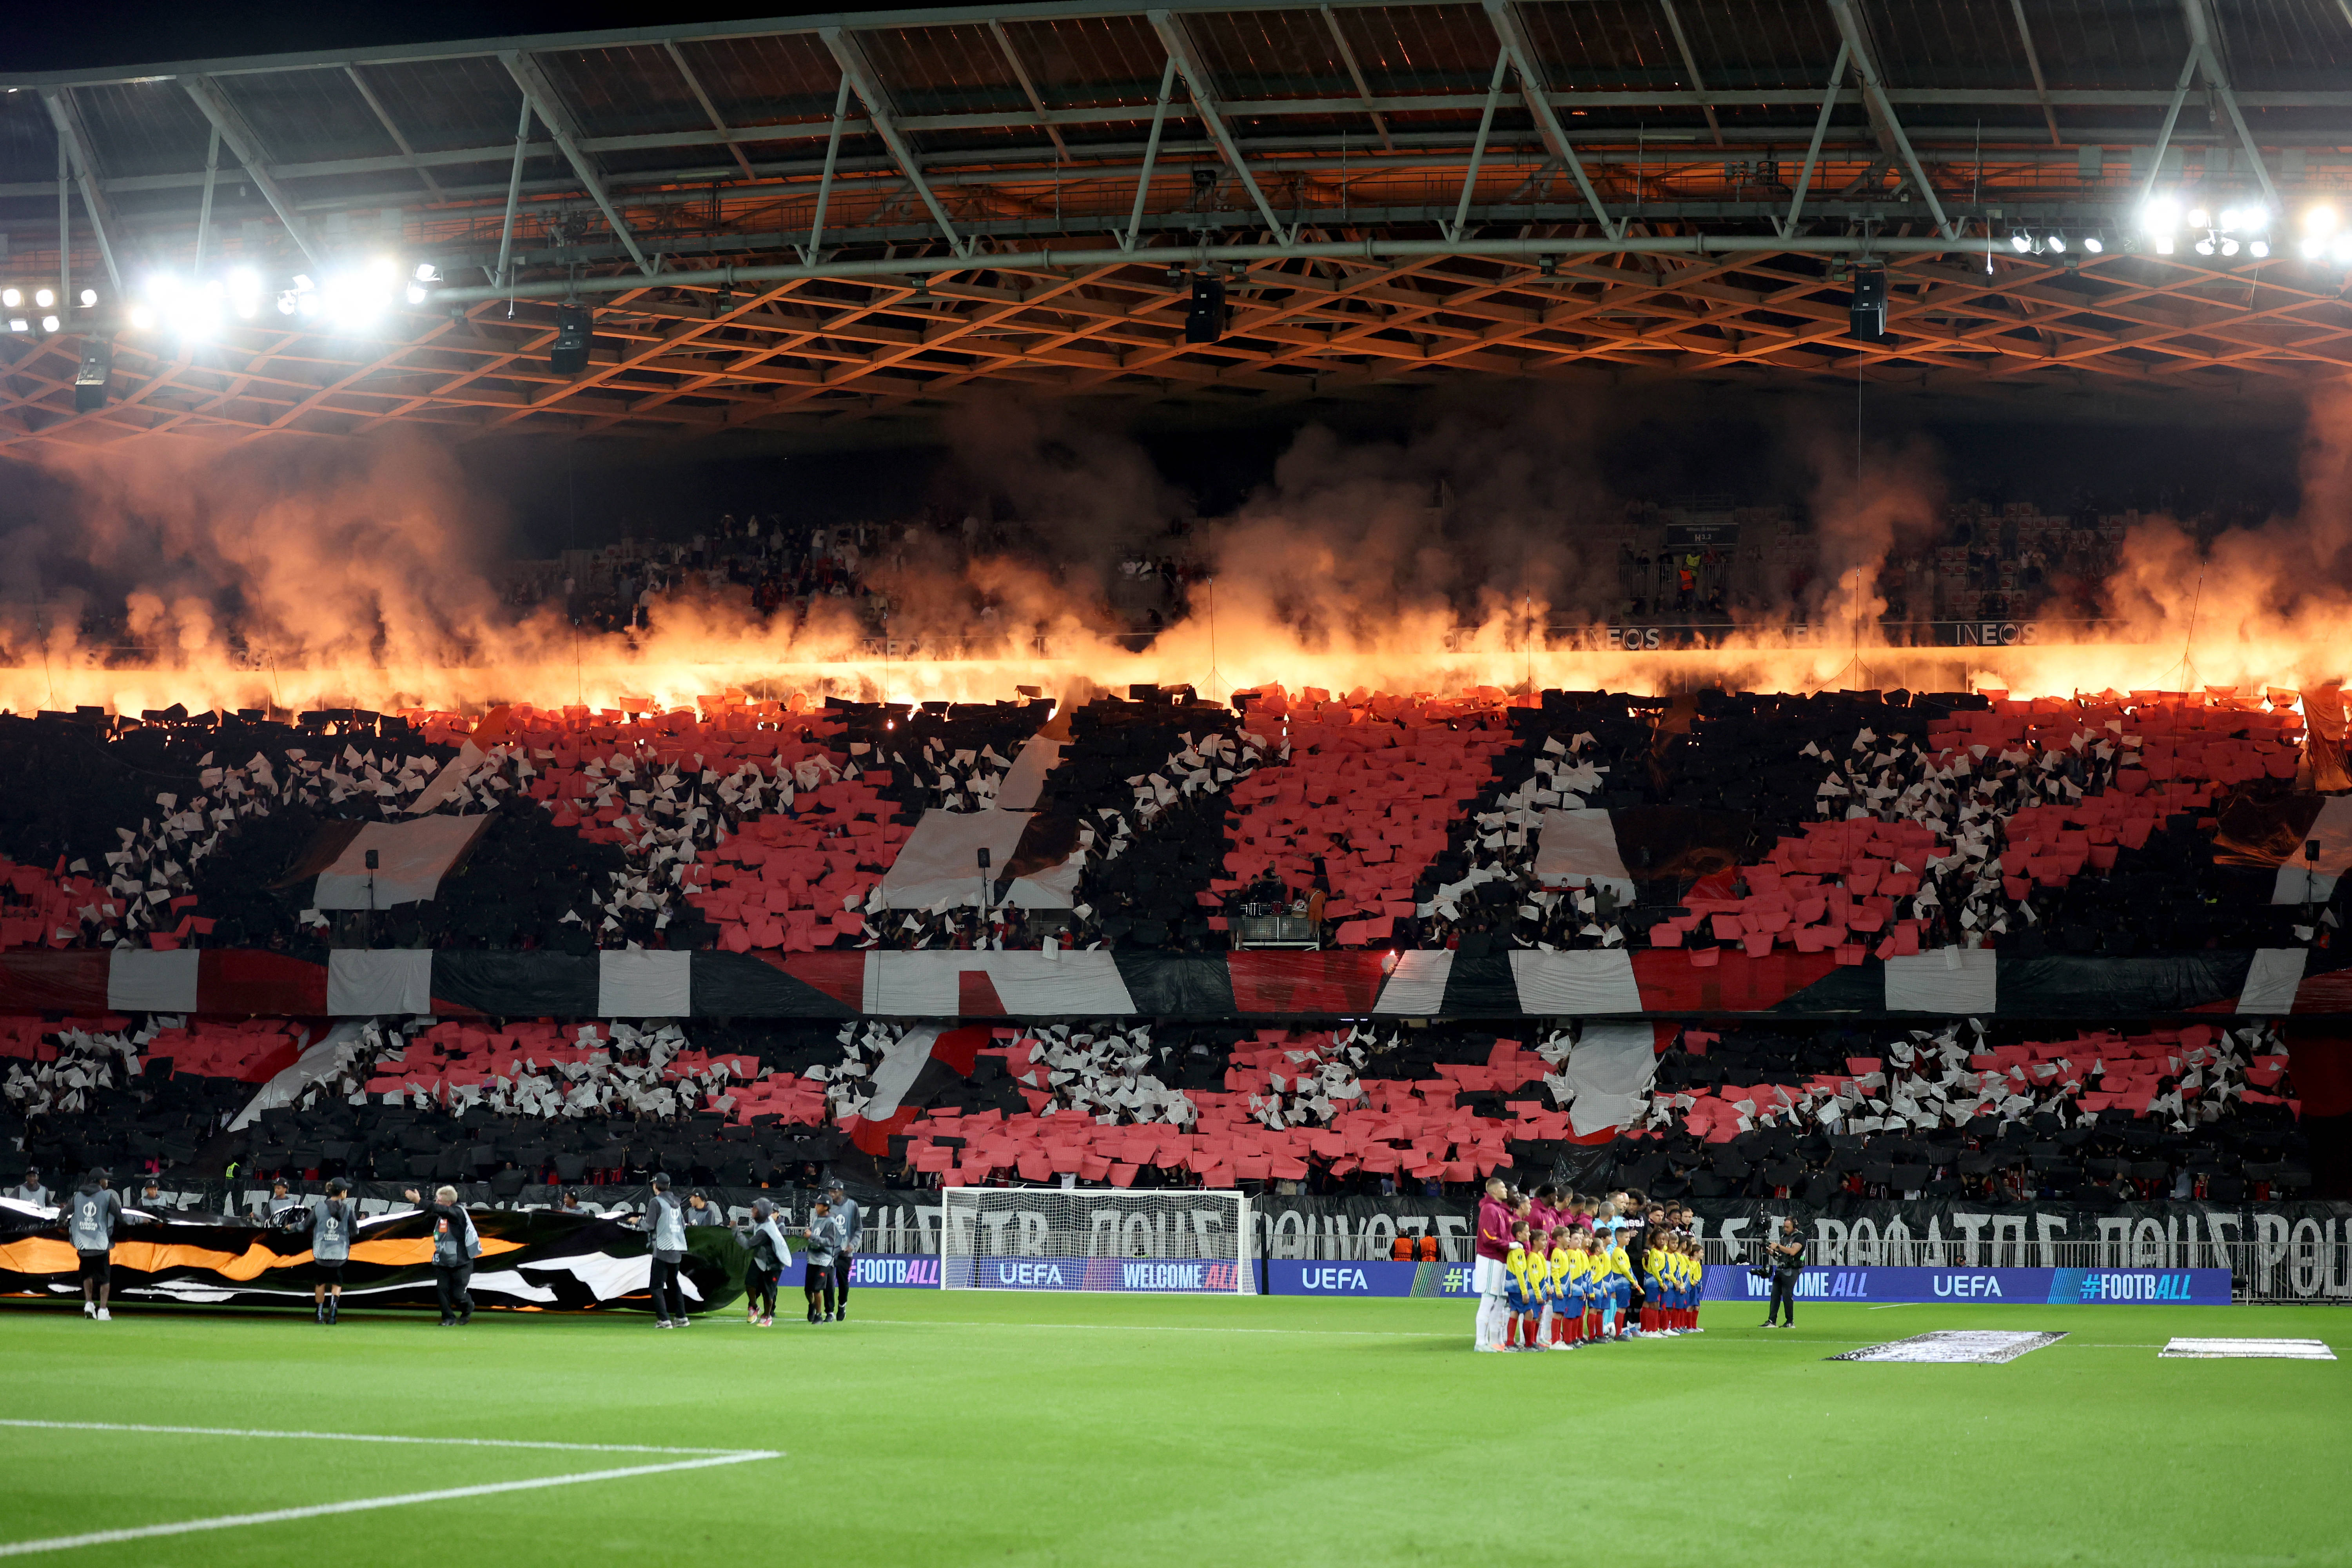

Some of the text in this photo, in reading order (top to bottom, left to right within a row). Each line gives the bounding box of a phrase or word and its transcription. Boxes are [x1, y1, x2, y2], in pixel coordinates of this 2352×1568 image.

[1581, 628, 1659, 650] INEOS
[1956, 622, 2037, 645] INEOS
[848, 1258, 938, 1284] #FOOTBALL
[1000, 1263, 1063, 1285] UEFA
[1123, 1263, 1202, 1289] WELCOME
[1302, 1268, 1368, 1290] UEFA
[1746, 1272, 1867, 1297] WEOME ALL
[1933, 1275, 2003, 1297] UEFA
[2080, 1274, 2192, 1300] #FOOTBALL
